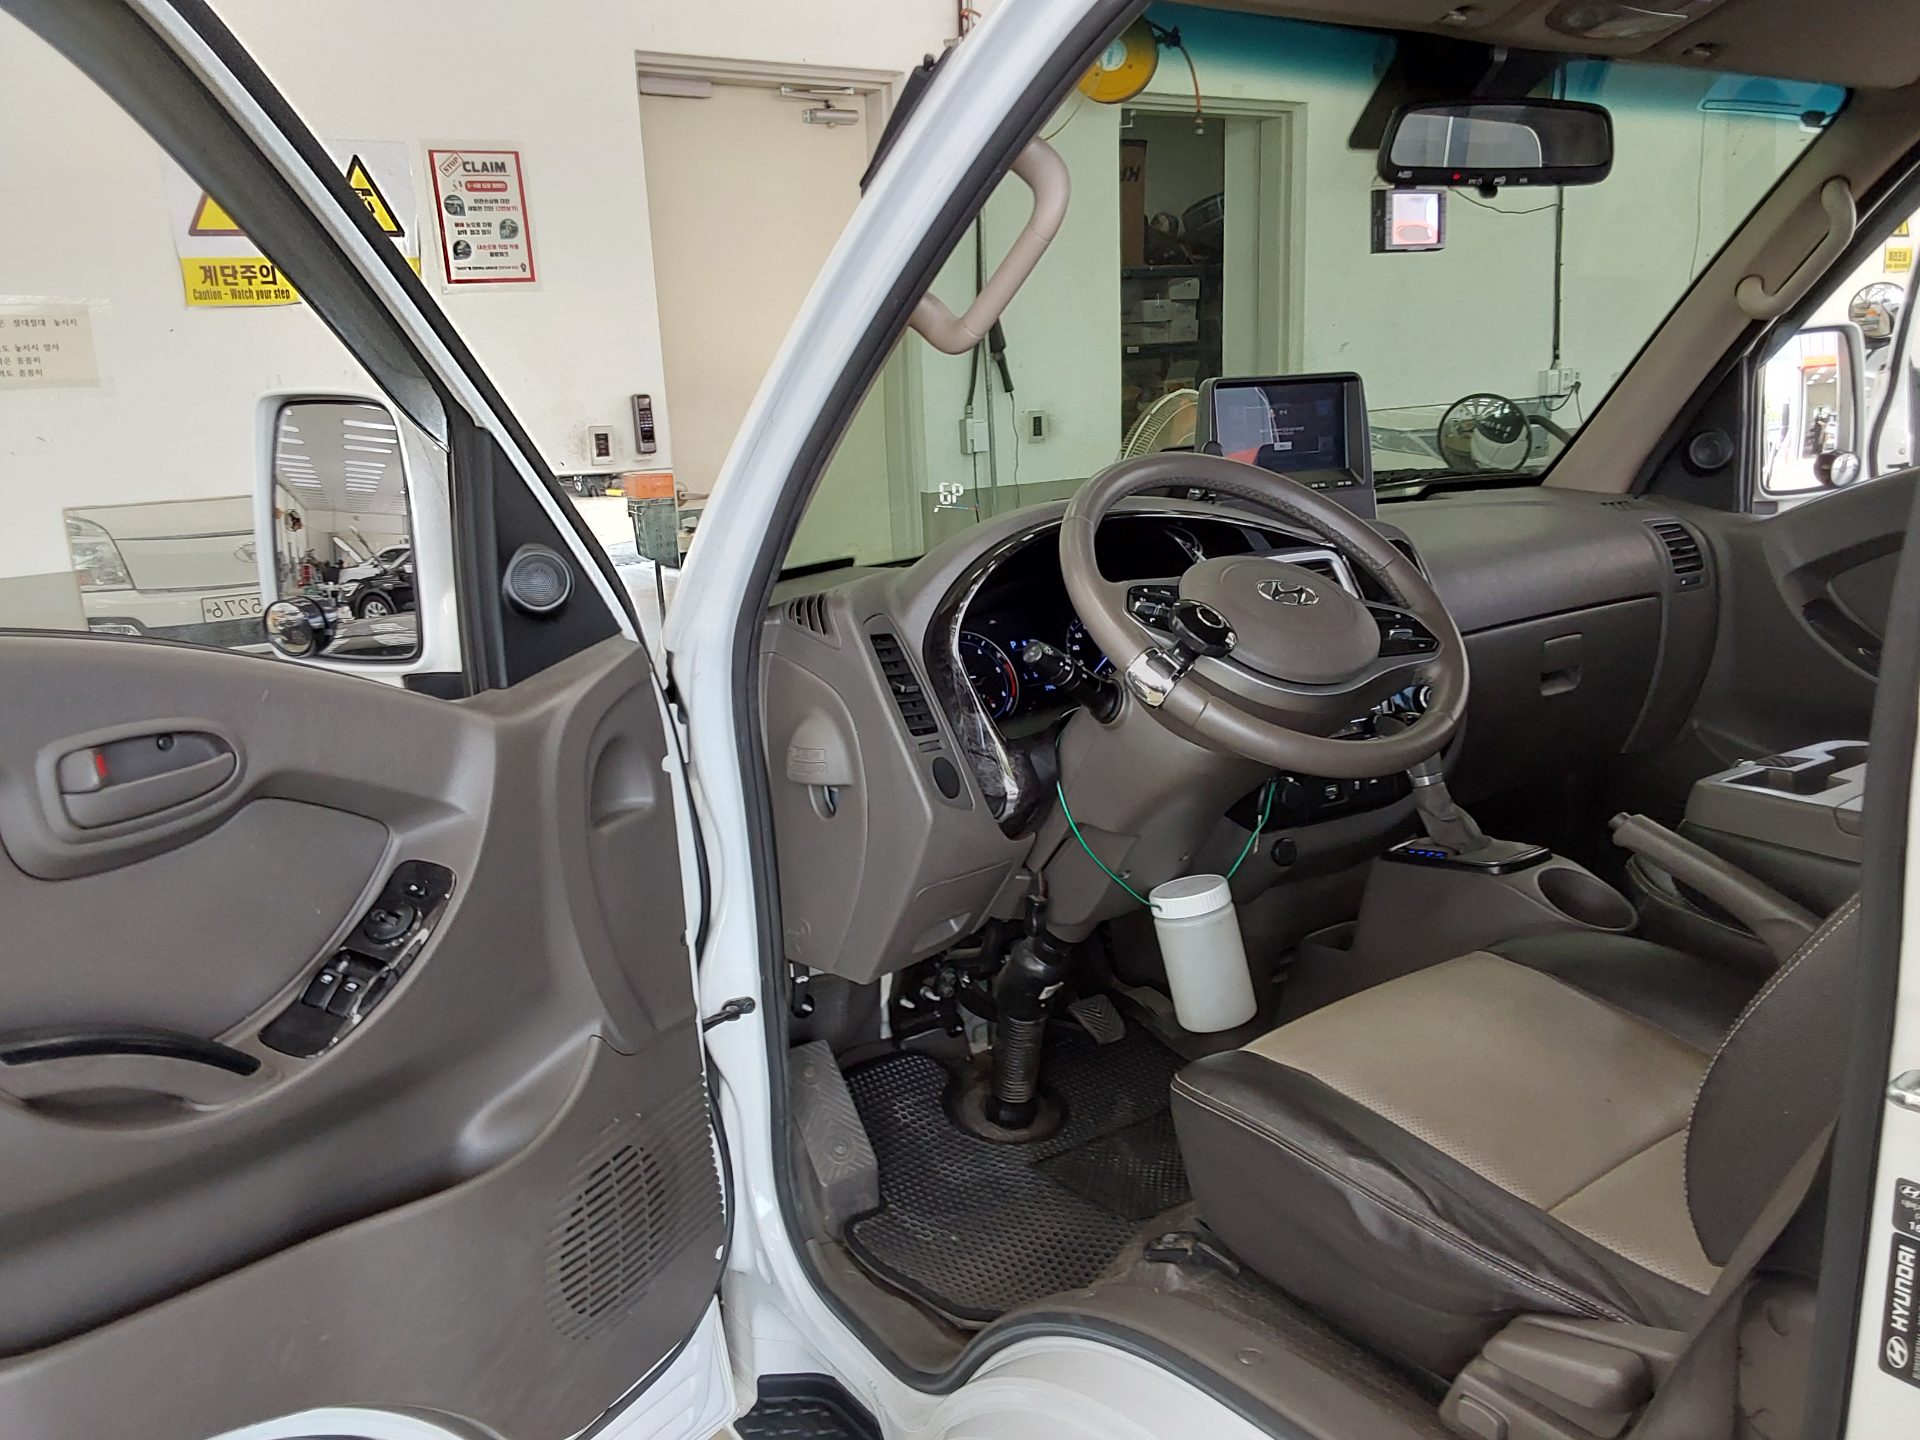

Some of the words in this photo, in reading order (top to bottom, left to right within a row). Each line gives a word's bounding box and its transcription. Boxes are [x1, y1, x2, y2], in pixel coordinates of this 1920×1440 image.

[443, 156, 459, 173] STOP
[462, 161, 507, 173] CLAIM
[199, 265, 279, 286] 계단주의
[193, 288, 222, 300] Caution
[229, 288, 254, 300] Watch
[255, 290, 272, 300] your
[274, 288, 290, 300] step
[1890, 1244, 1917, 1333] HYUNDAI
